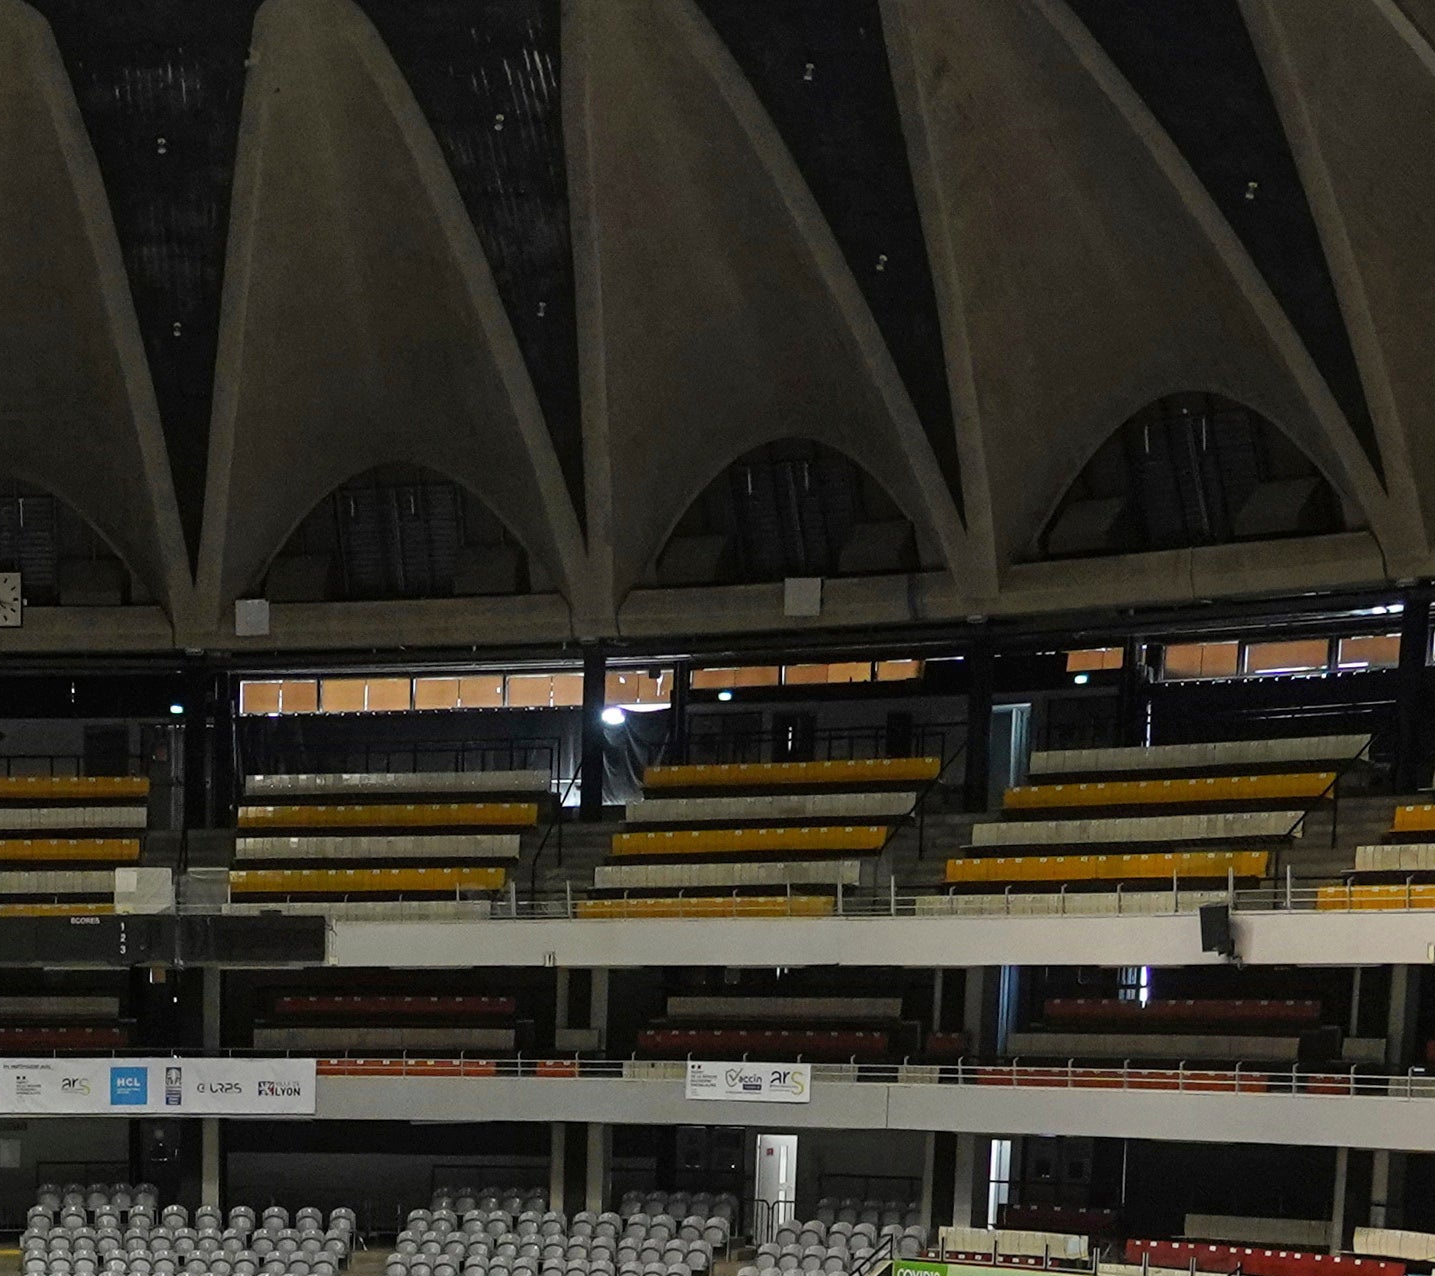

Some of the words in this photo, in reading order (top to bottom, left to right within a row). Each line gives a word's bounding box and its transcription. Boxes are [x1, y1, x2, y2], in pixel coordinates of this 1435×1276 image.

[70, 916, 100, 925] SCORES
[120, 934, 126, 943] 2
[117, 1077, 140, 1087] HCL
[275, 1087, 301, 1097] LYON
